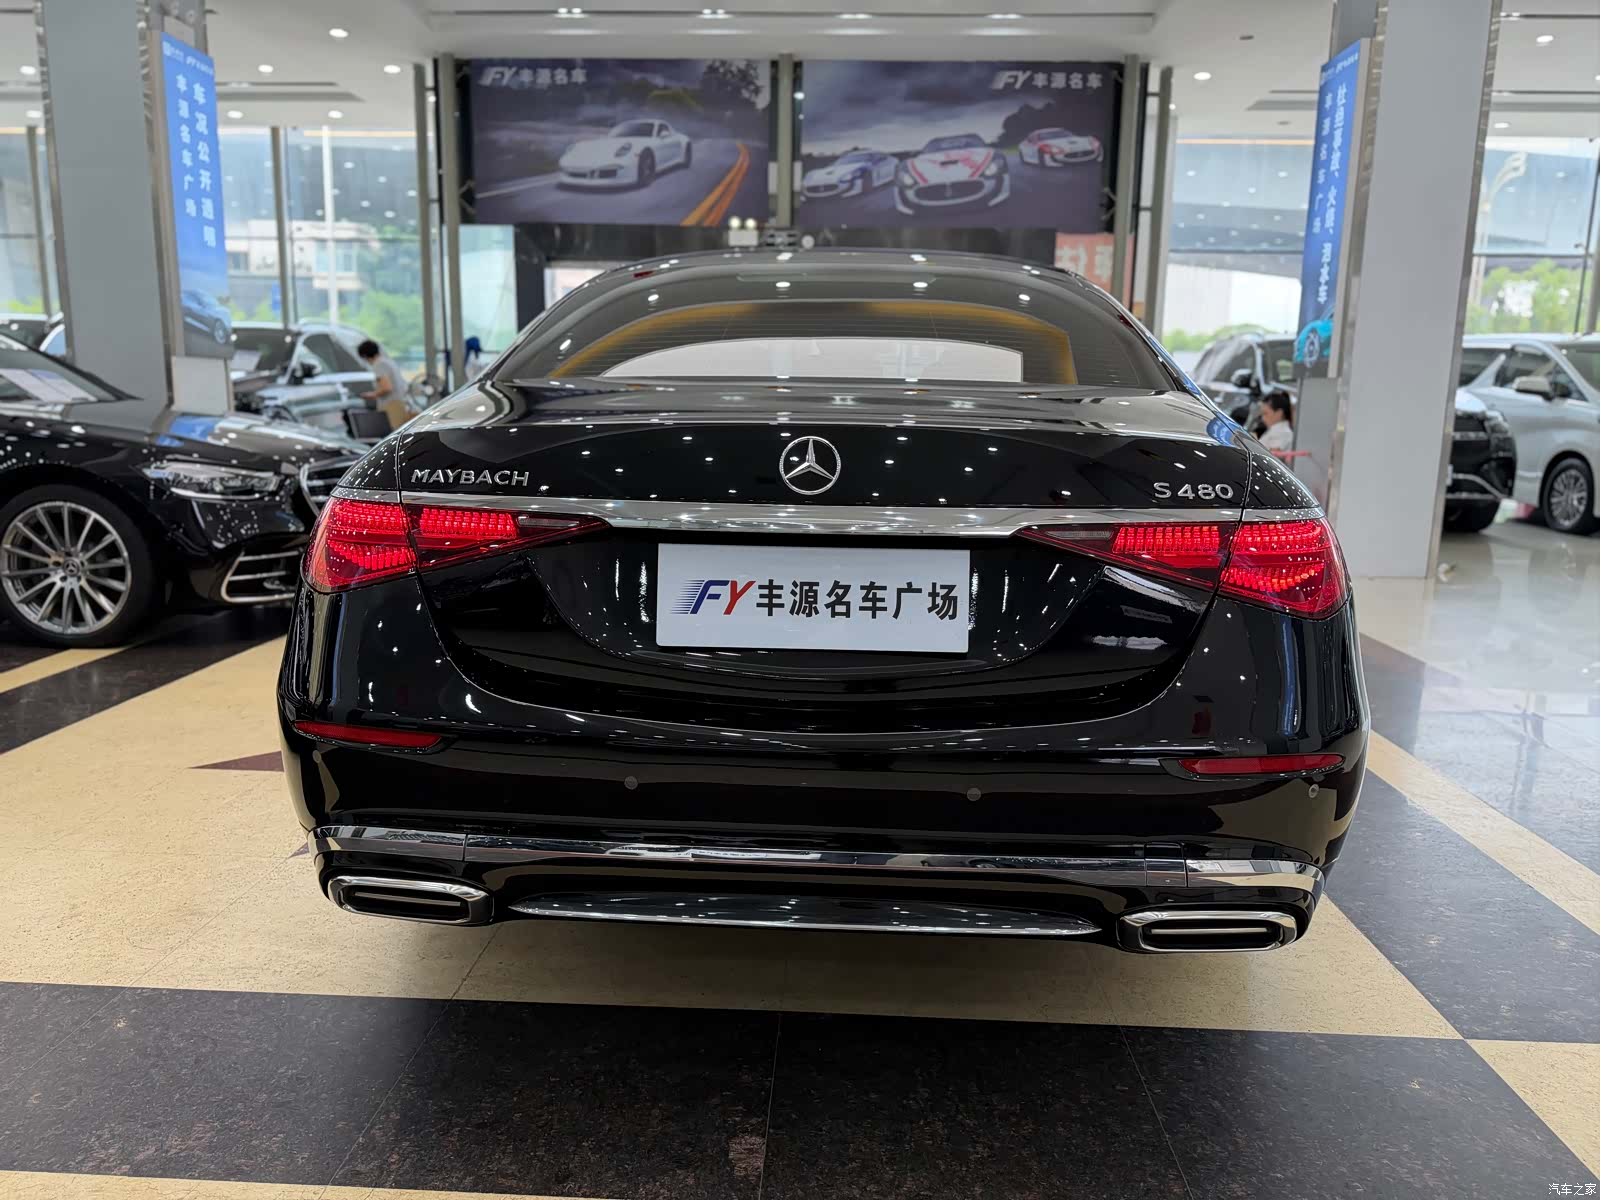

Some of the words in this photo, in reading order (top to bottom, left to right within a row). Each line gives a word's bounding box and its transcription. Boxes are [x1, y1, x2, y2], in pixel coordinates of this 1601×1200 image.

[479, 66, 517, 87] FY
[518, 67, 587, 85] 丰源名车
[991, 70, 1032, 90] FY
[1032, 72, 1103, 90] 丰源名车
[411, 469, 529, 486] MAYBACH
[676, 580, 756, 616] FY
[756, 579, 958, 620] 丰源名车广场
